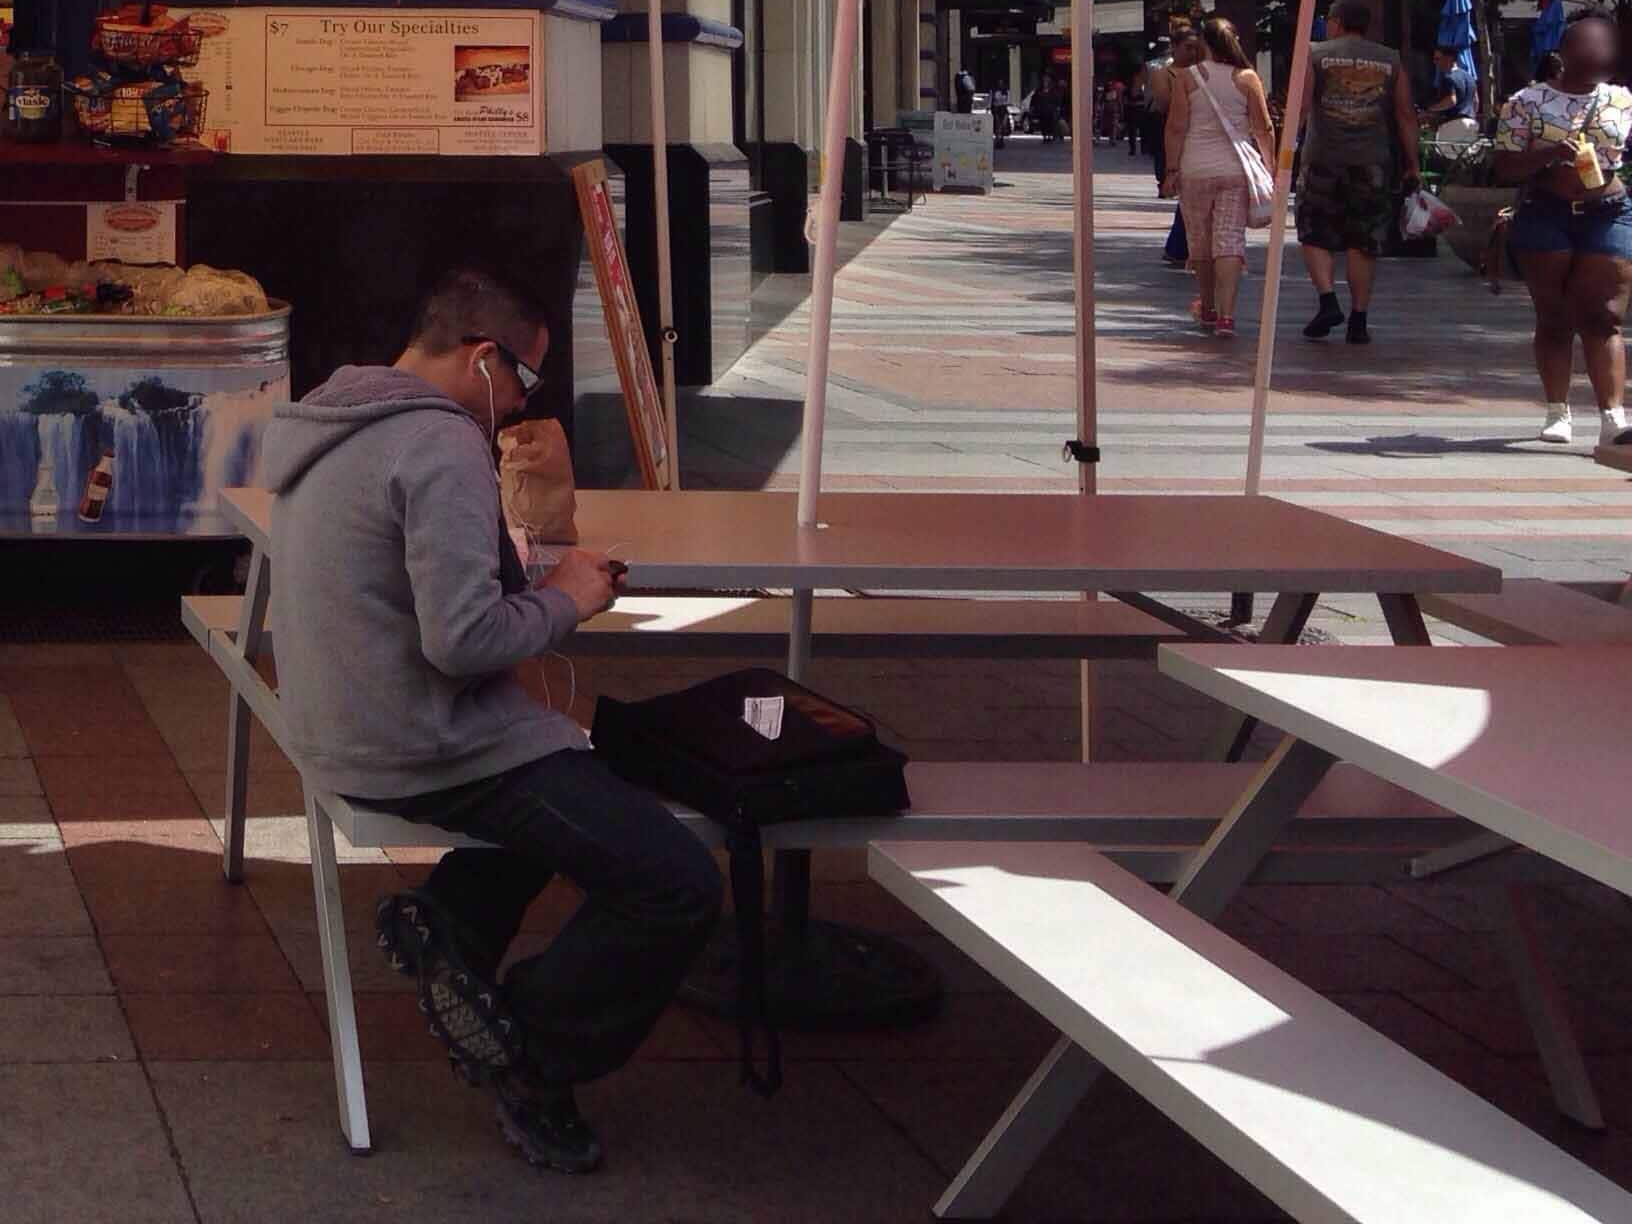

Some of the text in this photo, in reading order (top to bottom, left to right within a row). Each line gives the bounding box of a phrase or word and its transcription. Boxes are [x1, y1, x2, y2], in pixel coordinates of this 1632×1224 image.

[270, 20, 479, 38] $7 Try Our Specialties
